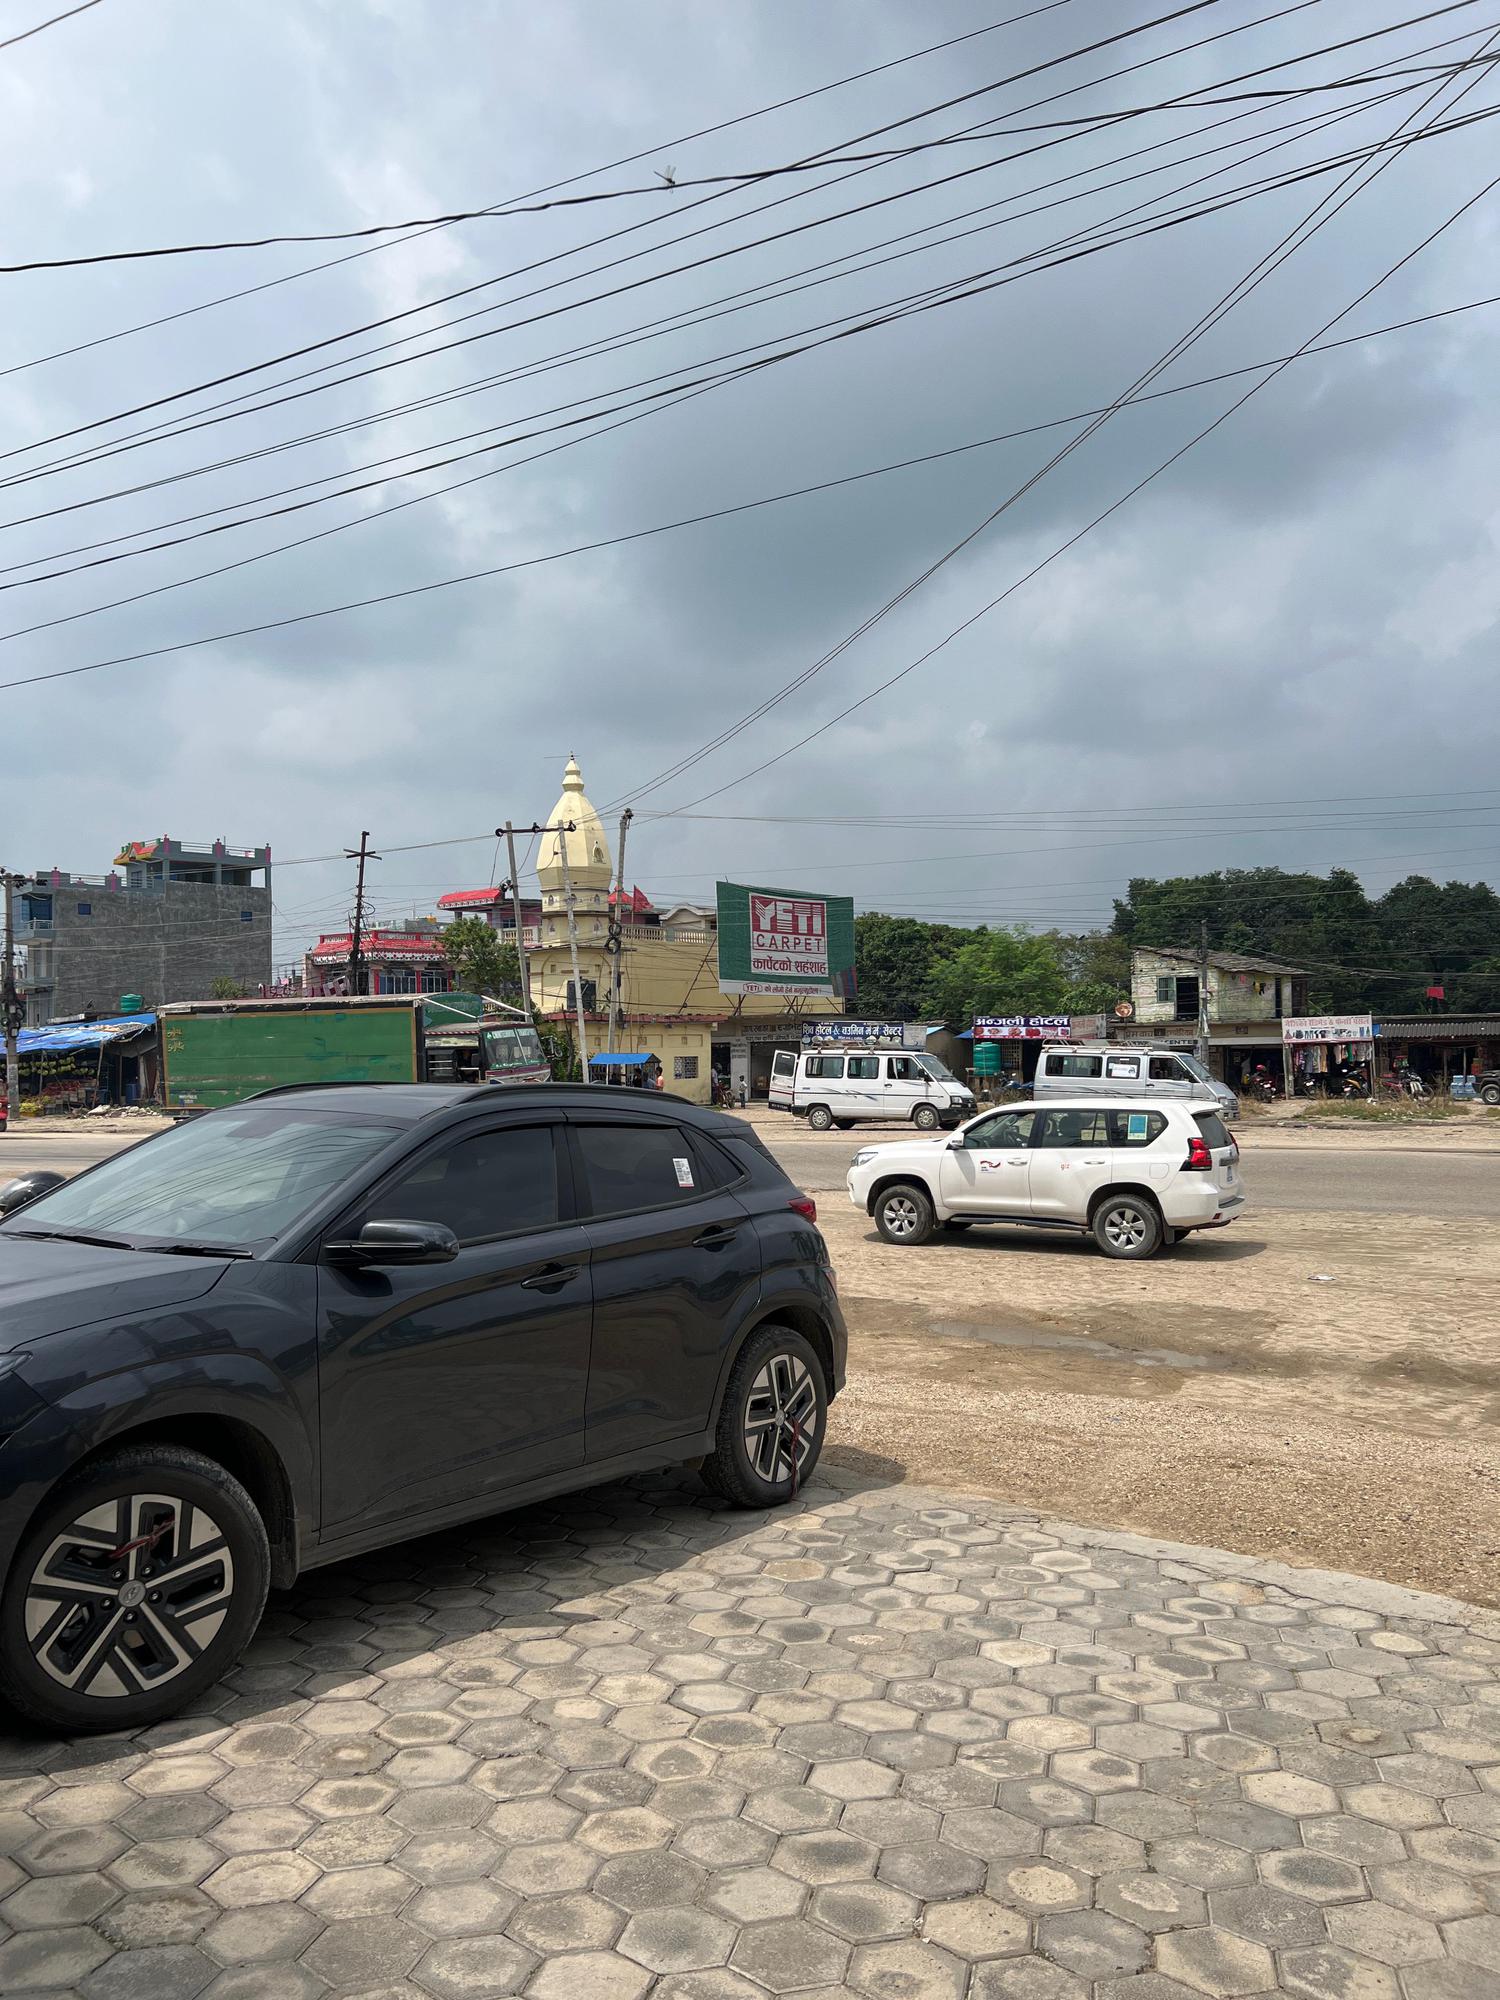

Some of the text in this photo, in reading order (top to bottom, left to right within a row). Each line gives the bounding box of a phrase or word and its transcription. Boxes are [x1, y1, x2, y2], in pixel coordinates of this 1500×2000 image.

[755, 899, 822, 935] YETI
[756, 934, 822, 952] CARPET
[1029, 1015, 1069, 1027] होटल
[815, 1023, 832, 1036] होटल
[882, 1023, 903, 1036] सेन्टर
